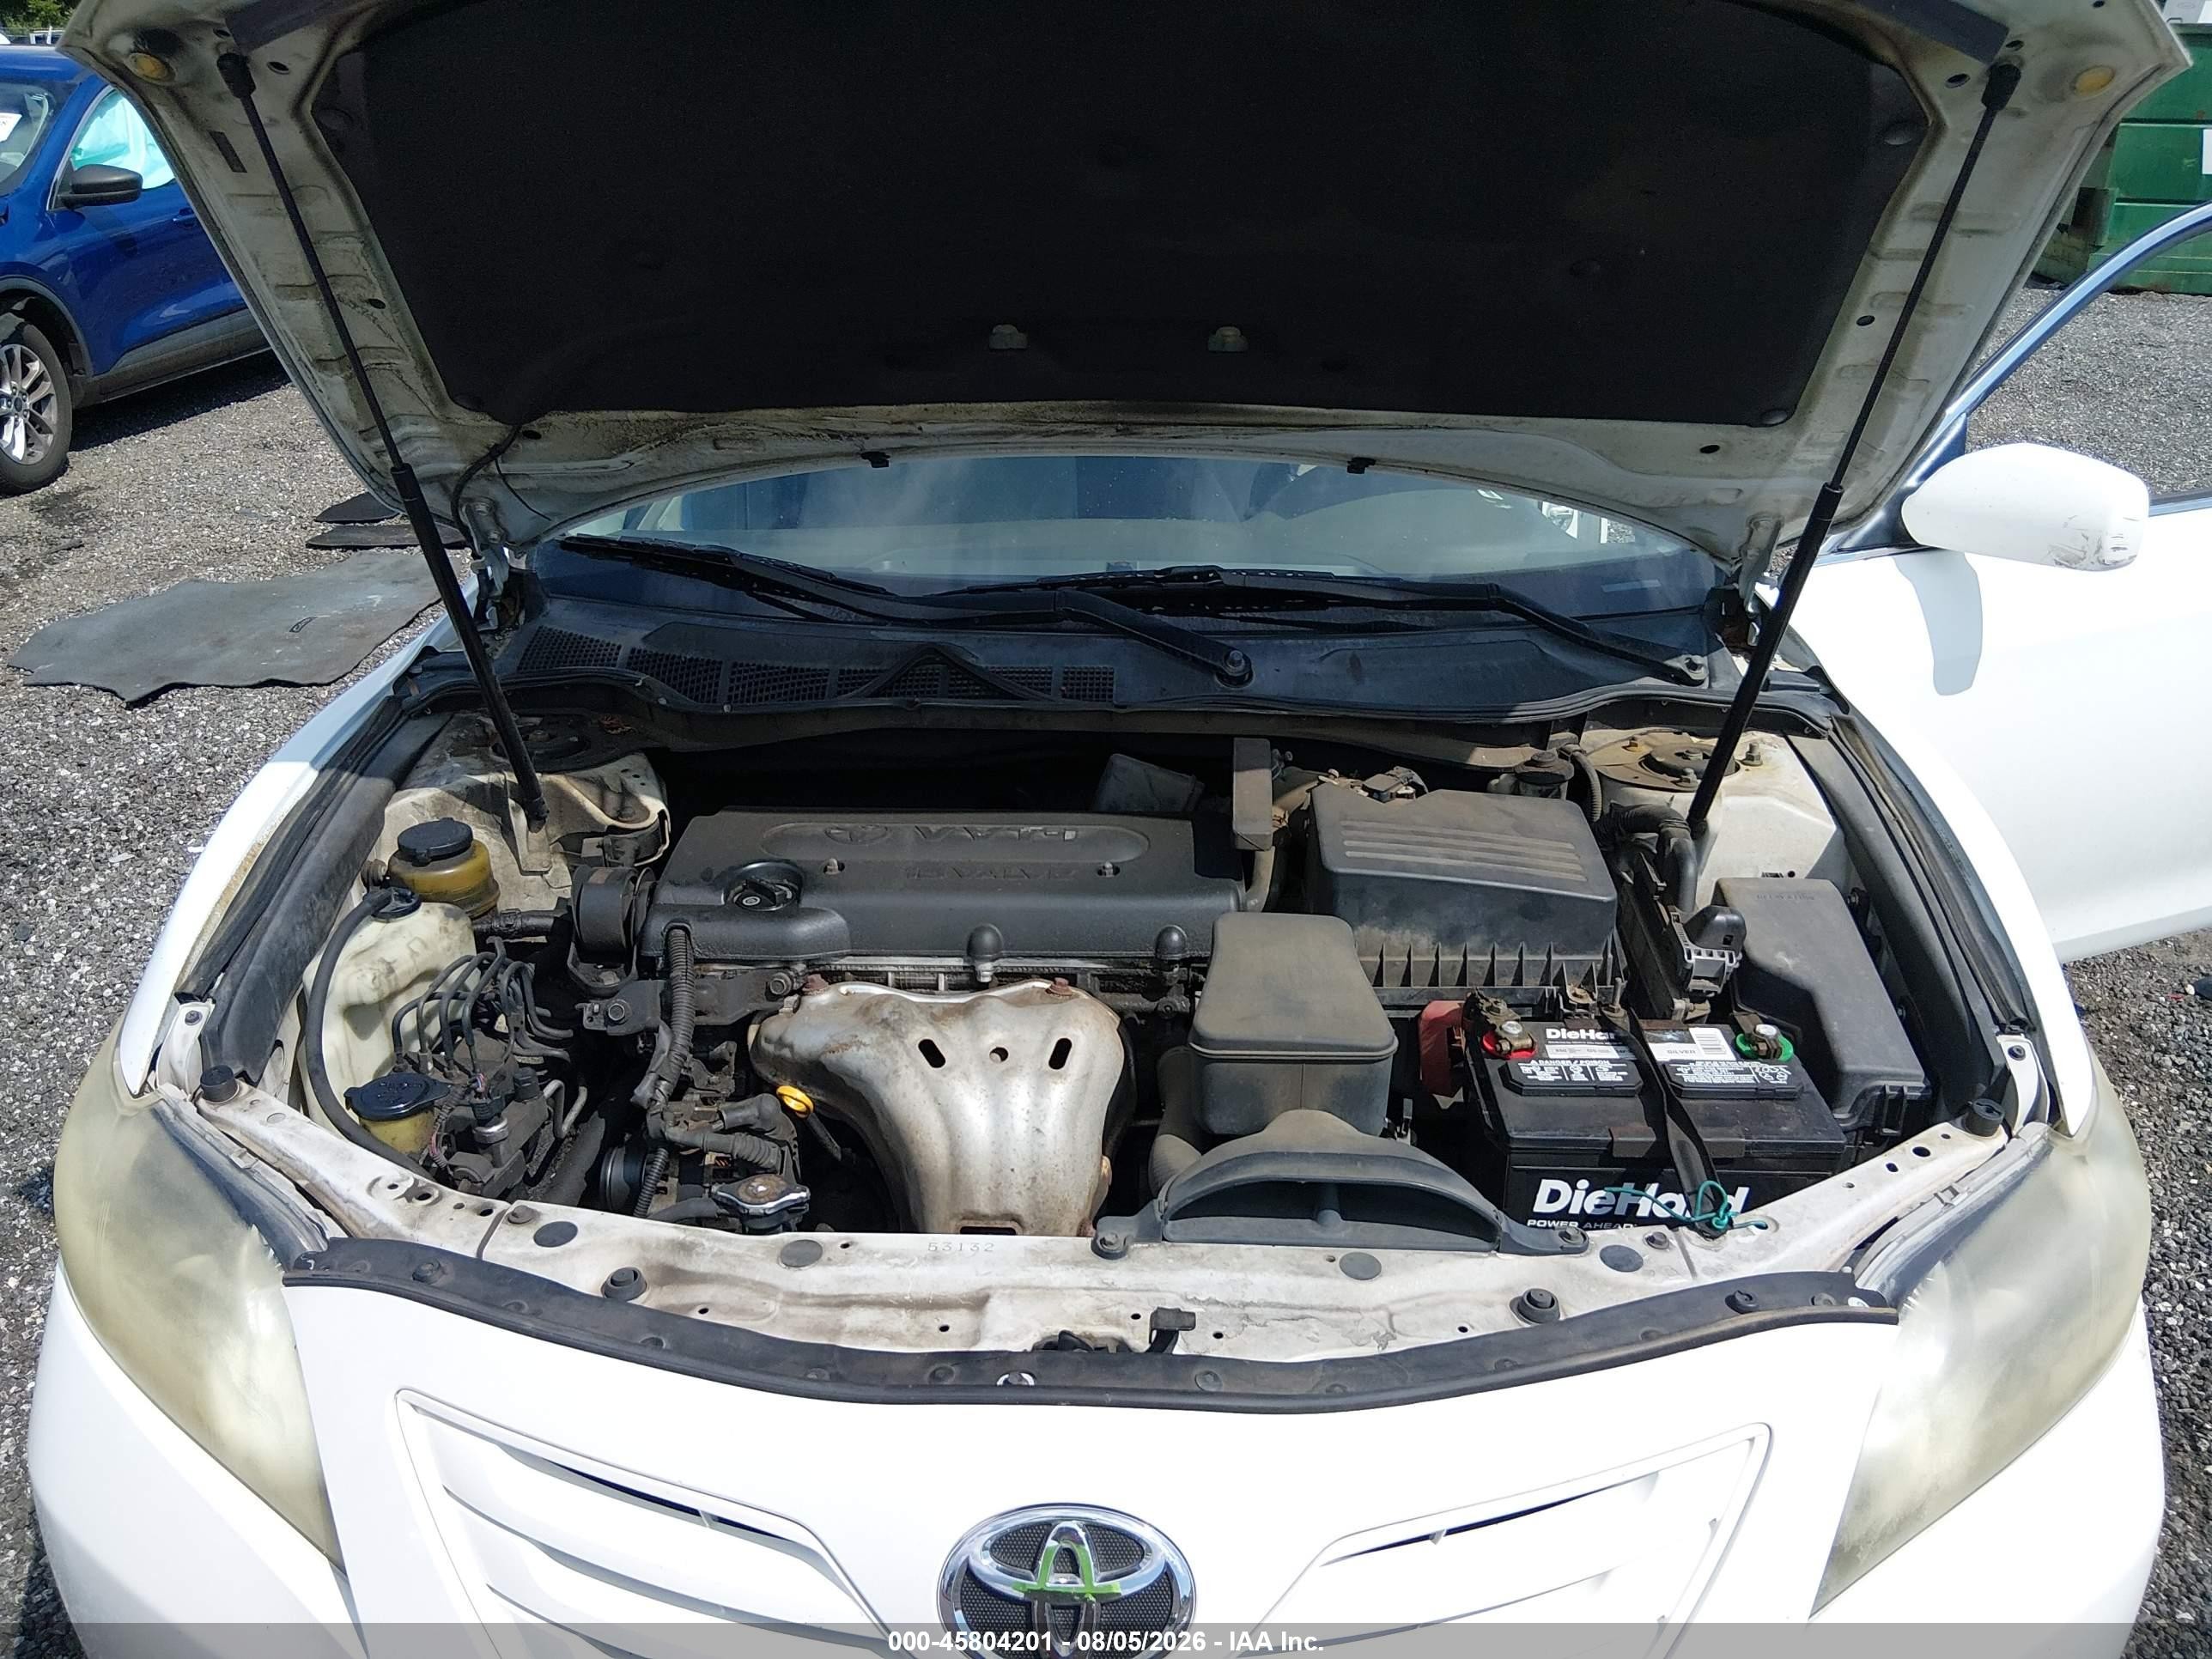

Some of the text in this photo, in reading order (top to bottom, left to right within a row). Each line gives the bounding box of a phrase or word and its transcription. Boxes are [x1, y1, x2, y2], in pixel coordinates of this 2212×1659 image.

[1533, 1179, 1749, 1218] DieHad
[1527, 1218, 1579, 1228] POWER
[927, 1242, 994, 1252] 53132
